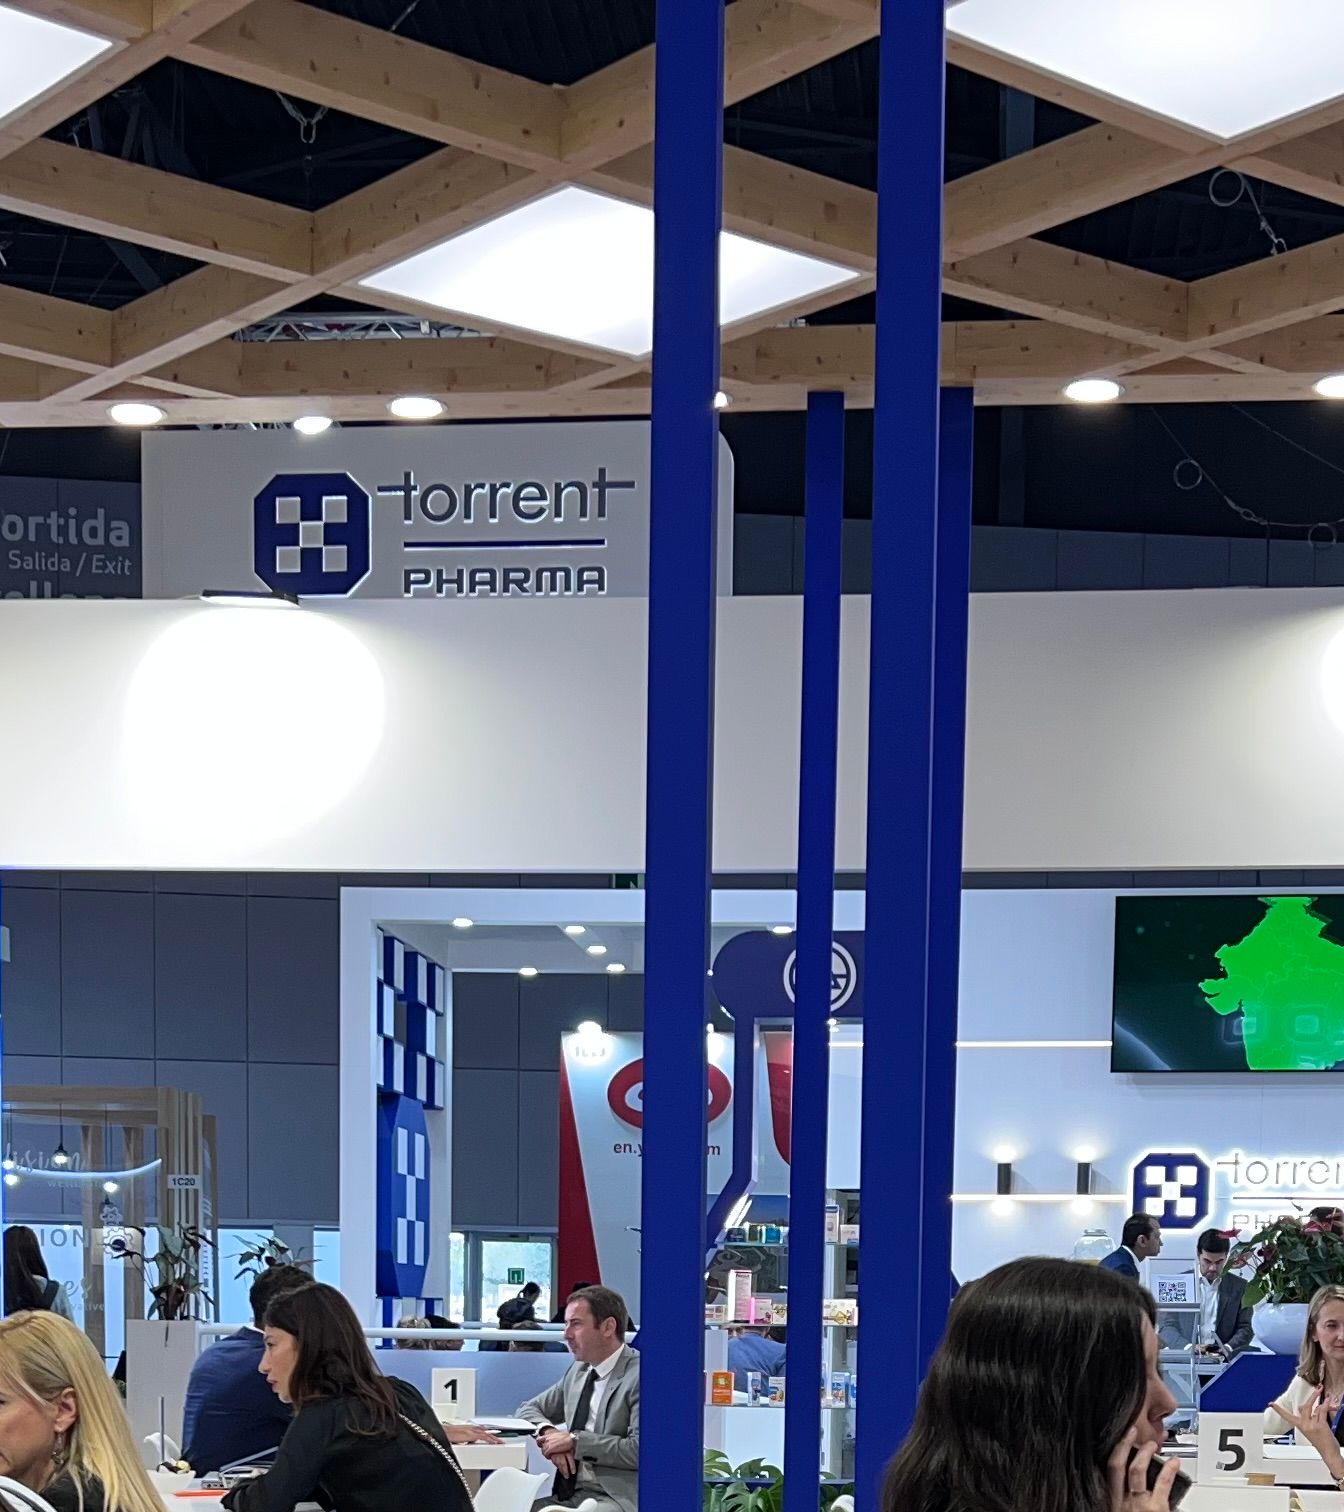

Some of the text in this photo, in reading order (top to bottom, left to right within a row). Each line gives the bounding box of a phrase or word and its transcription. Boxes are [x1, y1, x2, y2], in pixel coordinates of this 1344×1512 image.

[376, 467, 636, 524] torrent
[8, 549, 71, 572] Salida
[91, 554, 132, 576] Exit
[403, 566, 607, 597] PHARMA
[444, 1378, 457, 1404] 1
[1218, 1428, 1246, 1471] 5
